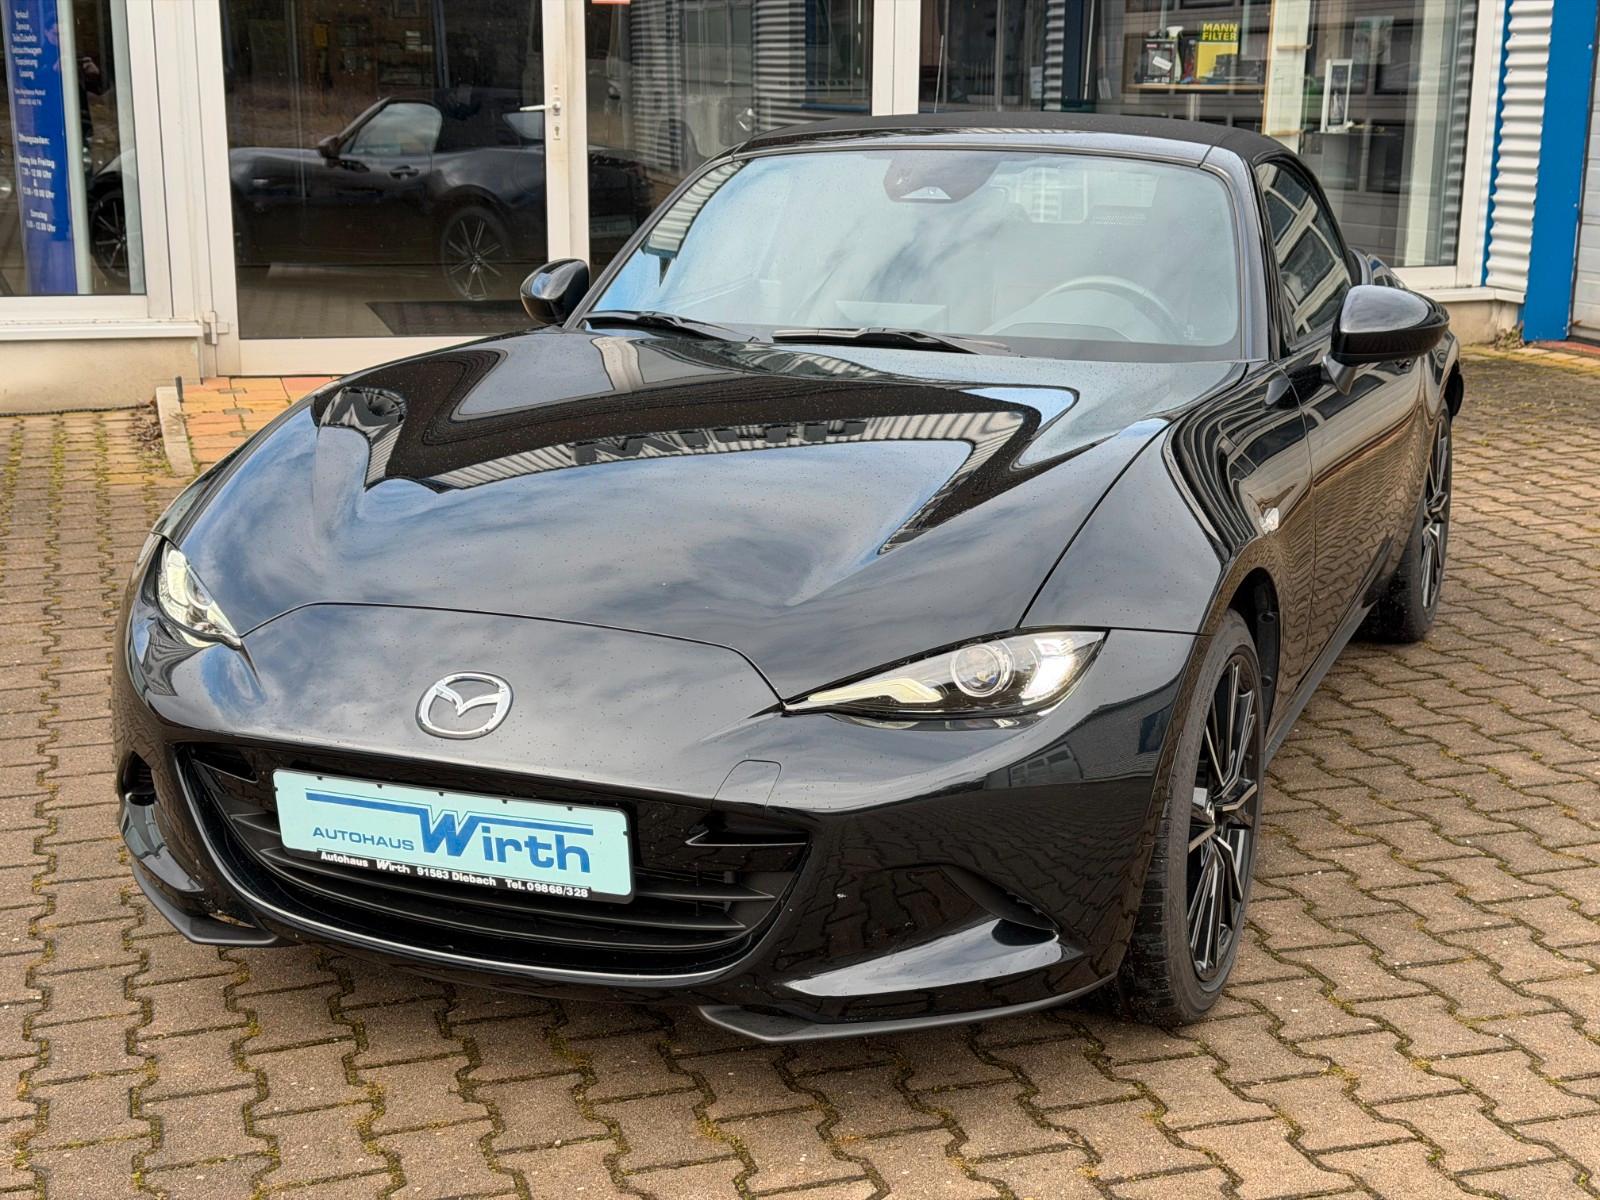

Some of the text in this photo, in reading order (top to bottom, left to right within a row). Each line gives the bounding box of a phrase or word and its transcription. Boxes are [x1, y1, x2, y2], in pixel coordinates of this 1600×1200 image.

[1202, 32, 1238, 41] FILTER
[1203, 23, 1238, 32] MANN
[312, 807, 591, 873] AUTOHAUS Wirth
[320, 851, 369, 868] Autohaus
[376, 859, 411, 874] Wirth
[417, 867, 450, 880] 91583
[452, 871, 497, 887] Diebach
